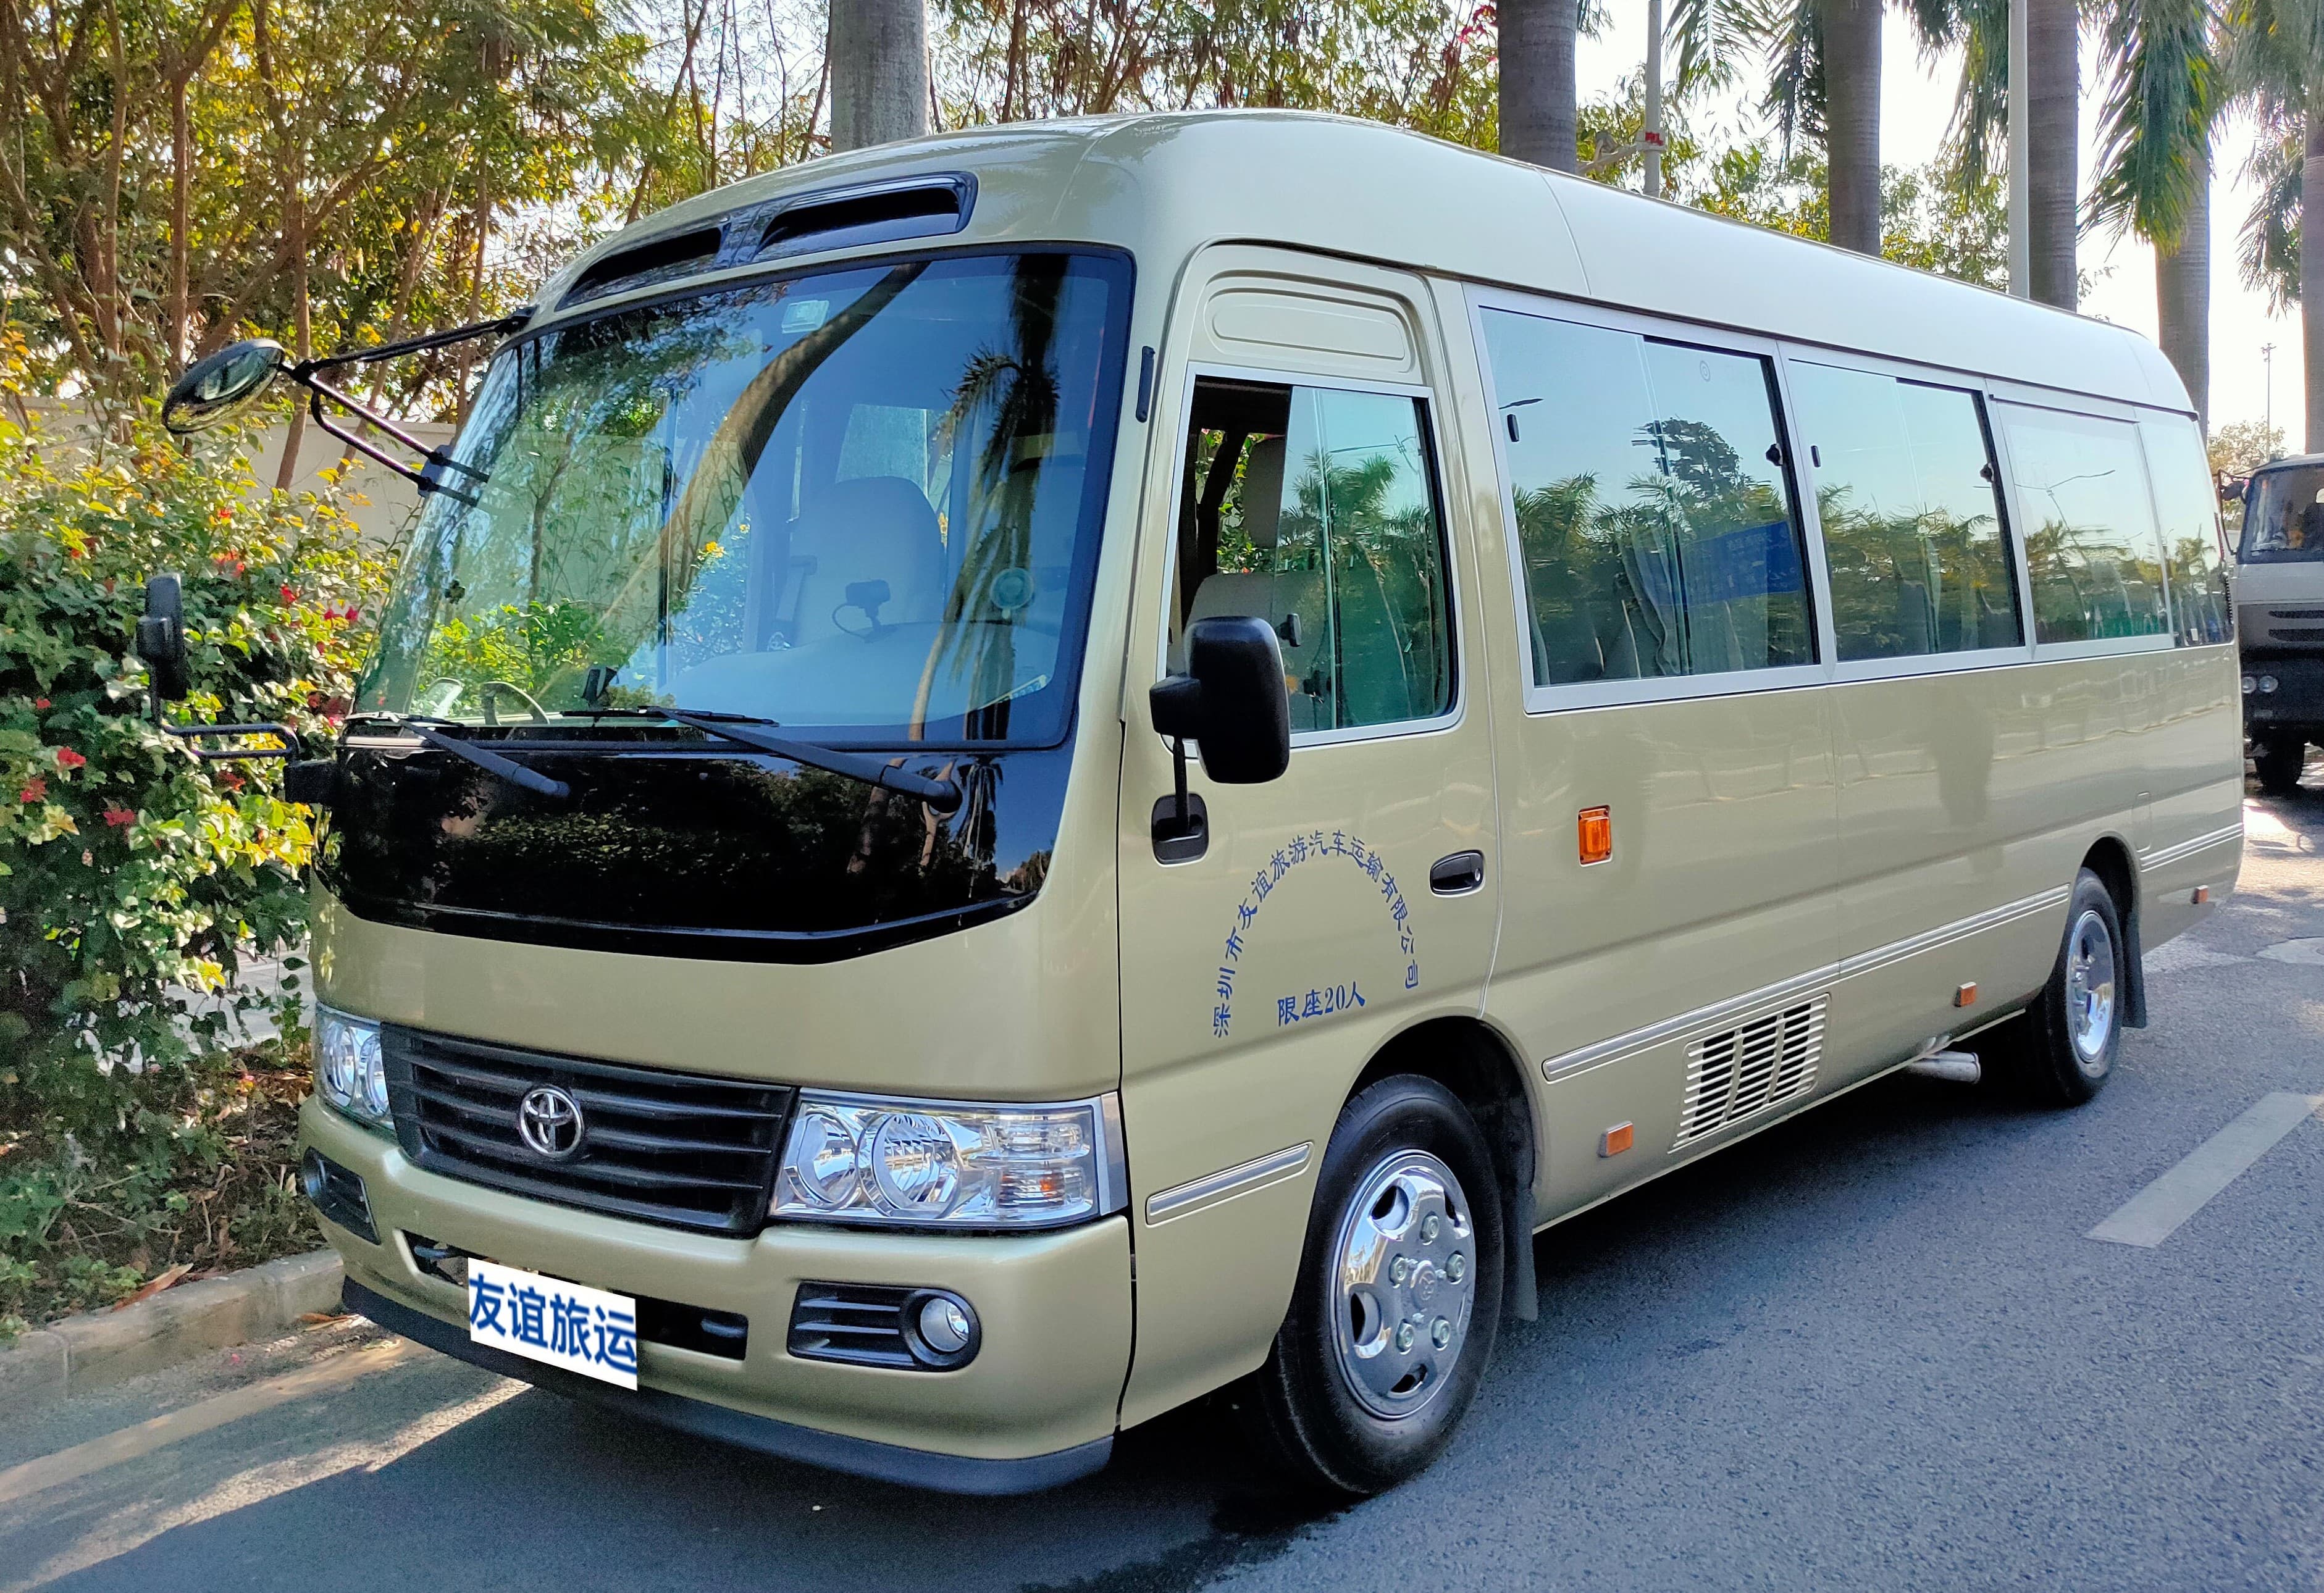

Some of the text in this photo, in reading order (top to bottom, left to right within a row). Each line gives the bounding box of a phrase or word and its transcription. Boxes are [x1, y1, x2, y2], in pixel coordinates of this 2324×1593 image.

[1214, 830, 1418, 1038] 深圳市友谊旅游汽车运输有限公司
[1277, 981, 1366, 1027] 限座20人
